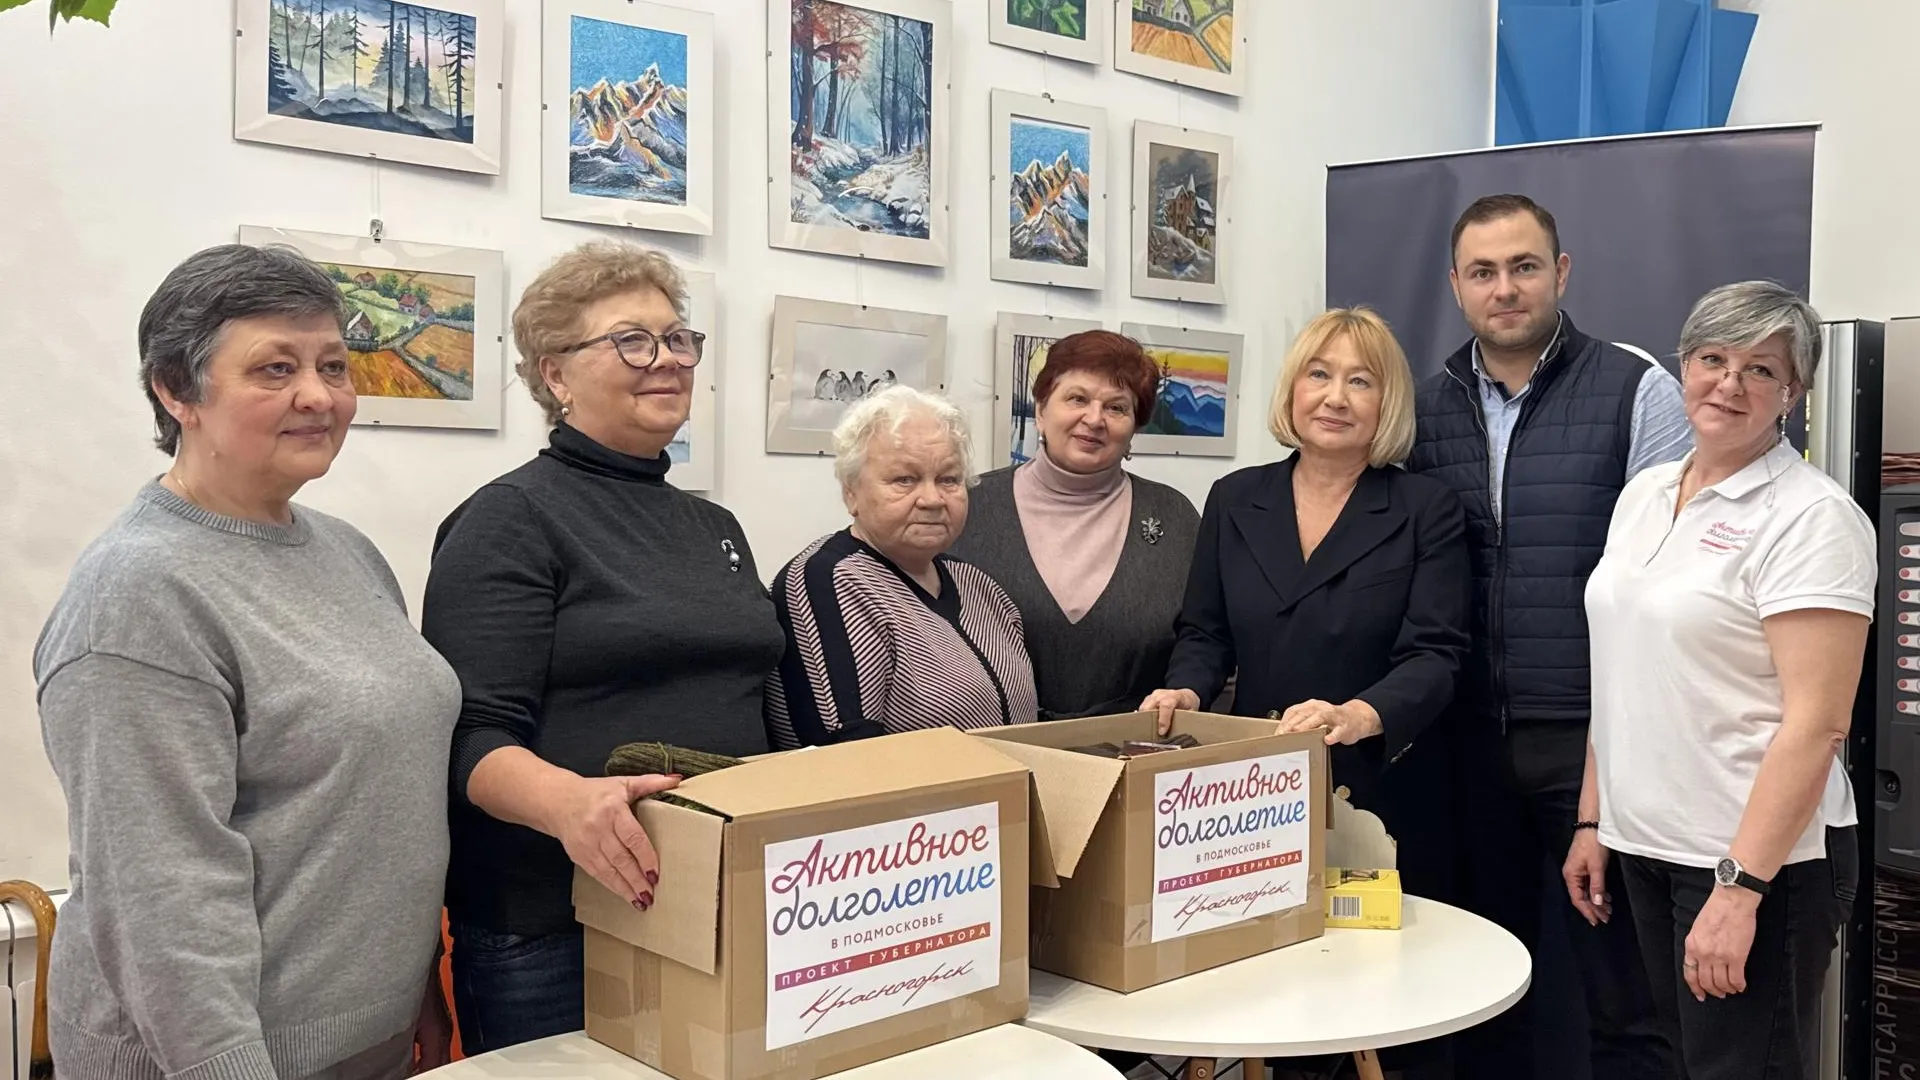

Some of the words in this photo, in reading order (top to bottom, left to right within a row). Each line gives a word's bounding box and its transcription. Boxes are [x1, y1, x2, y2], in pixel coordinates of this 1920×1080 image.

[1158, 762, 1303, 815] Активное
[1158, 800, 1306, 849] долголетие
[771, 821, 989, 894] Активное
[1162, 872, 1210, 890] ПРОЕКТ
[1219, 852, 1300, 878] ГУБЕРНАТОРА
[1196, 854, 1201, 864] В
[1204, 840, 1271, 861] ПОДМОСКОВЬЕ
[772, 862, 995, 936] долголетие
[1173, 880, 1291, 931] Красногорск
[781, 959, 852, 986] ПРОЕКТ
[869, 926, 987, 964] ГУБЕРНАТОРА
[831, 938, 839, 949] В
[843, 913, 944, 946] ПОДМОСКОВЬЕ
[799, 959, 975, 1033] Красногорск
